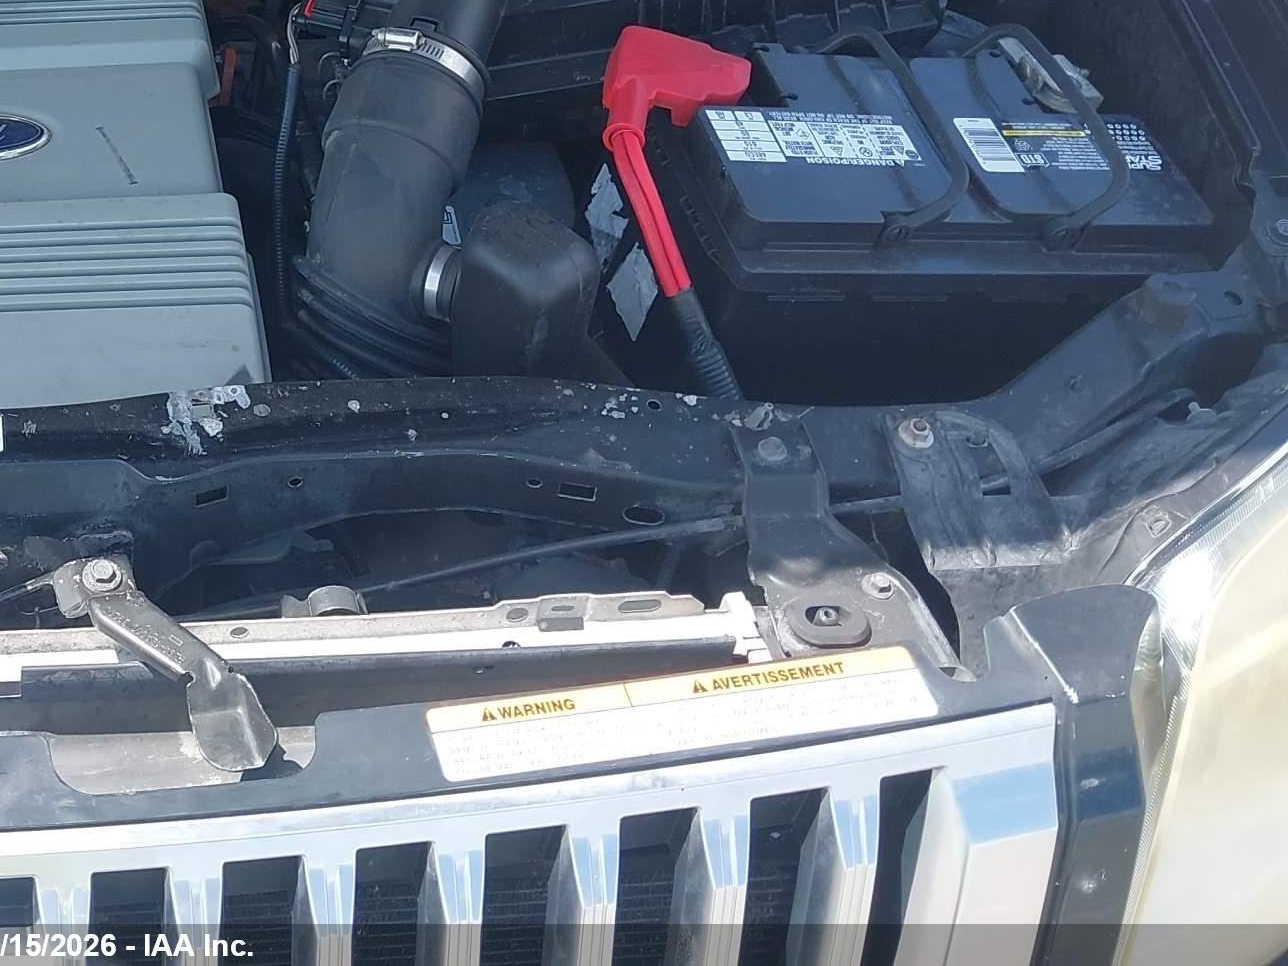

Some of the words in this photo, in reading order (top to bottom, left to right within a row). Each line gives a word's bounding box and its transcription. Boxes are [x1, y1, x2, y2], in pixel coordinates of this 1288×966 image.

[1125, 155, 1162, 164] STA
[1127, 163, 1161, 171] SUP
[711, 662, 846, 691] AVERTISSEMENT
[497, 698, 577, 720] WARNING
